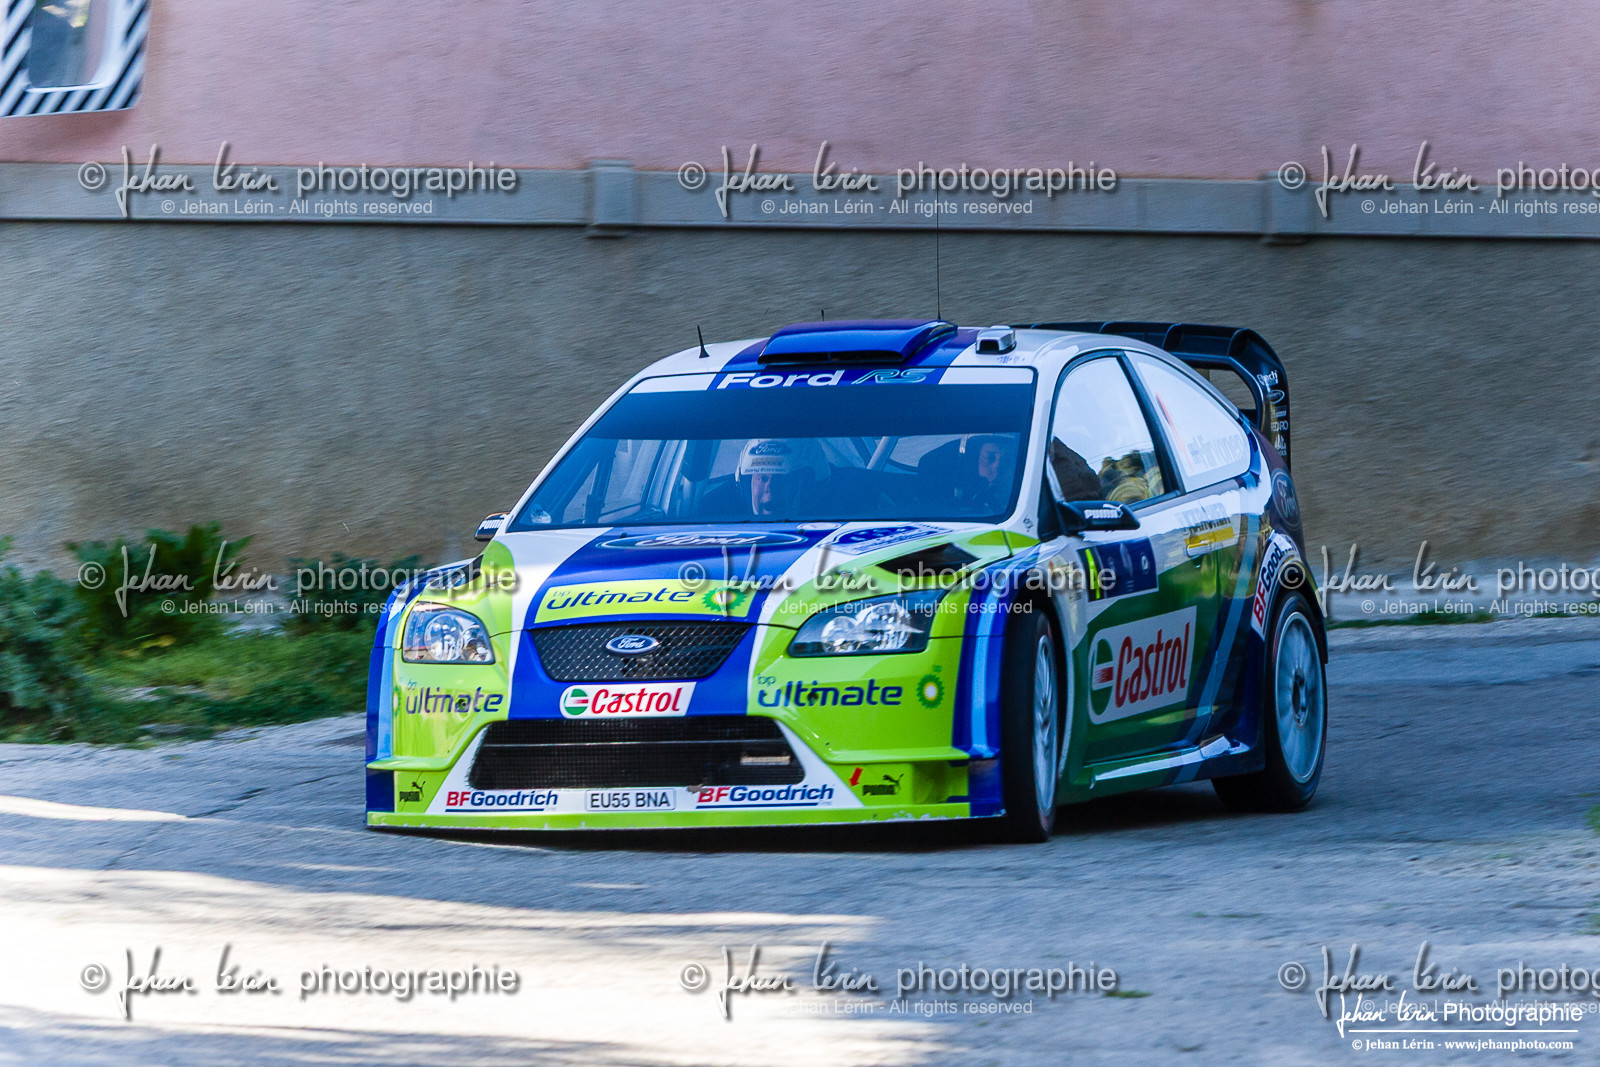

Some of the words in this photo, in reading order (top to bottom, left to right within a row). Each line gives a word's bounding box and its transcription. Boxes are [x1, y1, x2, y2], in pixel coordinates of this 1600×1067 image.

[716, 369, 846, 390] Ford
[851, 368, 936, 384] RS
[546, 588, 696, 610] ultimate
[617, 636, 645, 649] Ford
[1115, 622, 1190, 708] Castrol
[406, 686, 504, 714] ultimate
[590, 687, 682, 714] Castrol
[758, 678, 903, 707] ultimate
[446, 790, 558, 806] BFGoodrich
[590, 793, 631, 808] EU55
[636, 792, 671, 808] BNA
[697, 784, 834, 802] BFGoodrich
